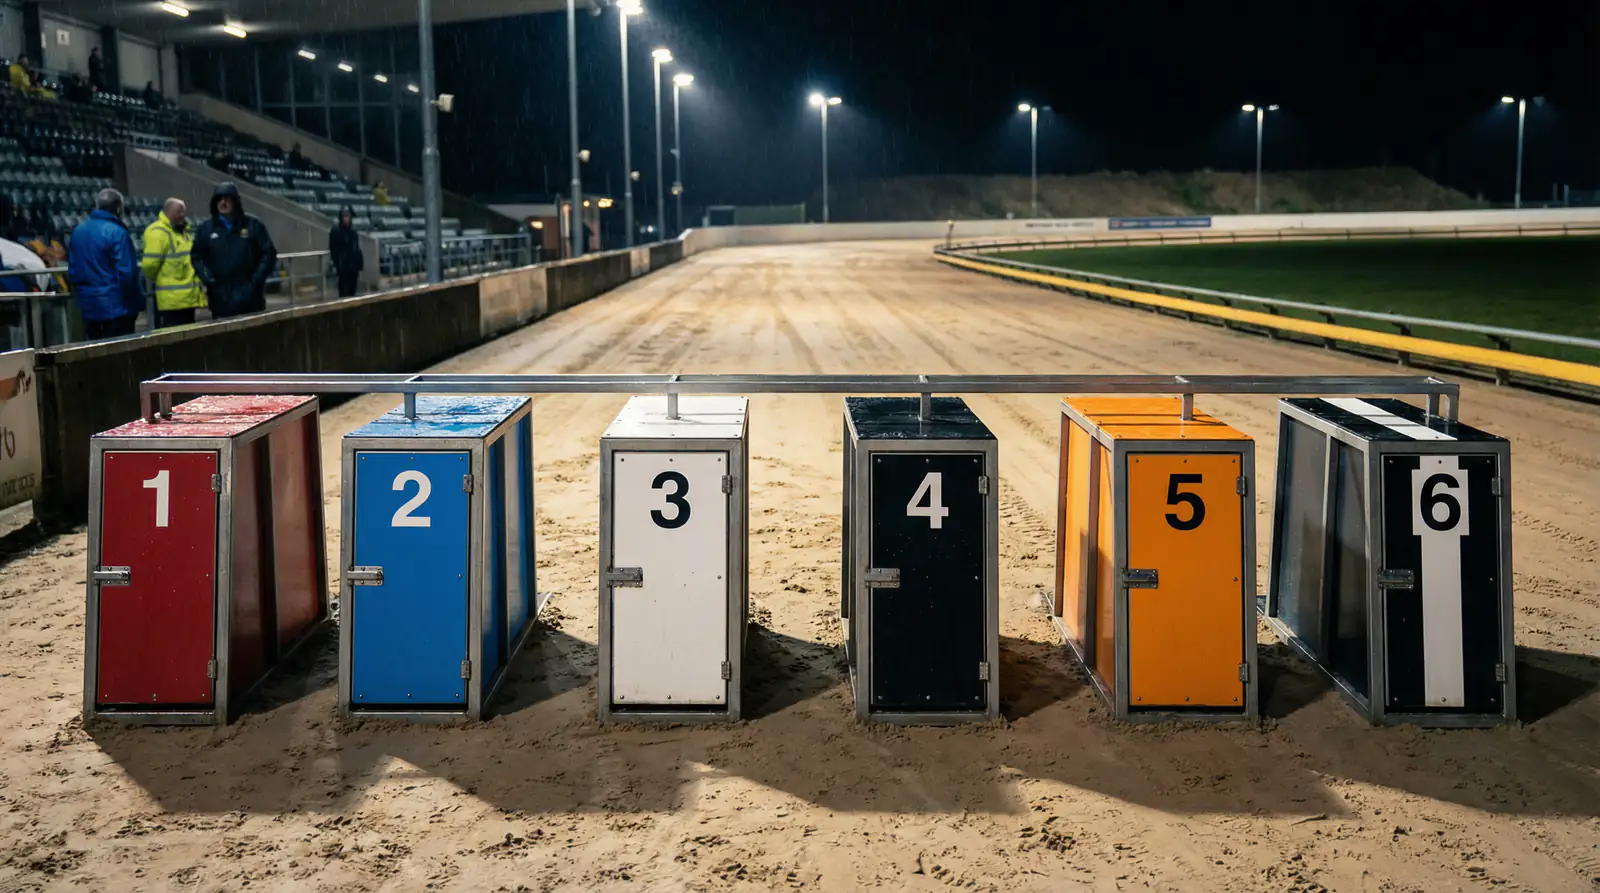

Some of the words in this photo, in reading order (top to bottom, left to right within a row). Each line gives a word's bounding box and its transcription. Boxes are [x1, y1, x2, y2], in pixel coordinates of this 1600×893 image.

[143, 470, 169, 527] 1
[392, 471, 431, 527] 2
[651, 471, 690, 529] 3
[907, 472, 948, 528] 4
[1165, 474, 1205, 530] 5
[1420, 474, 1461, 531] 6
